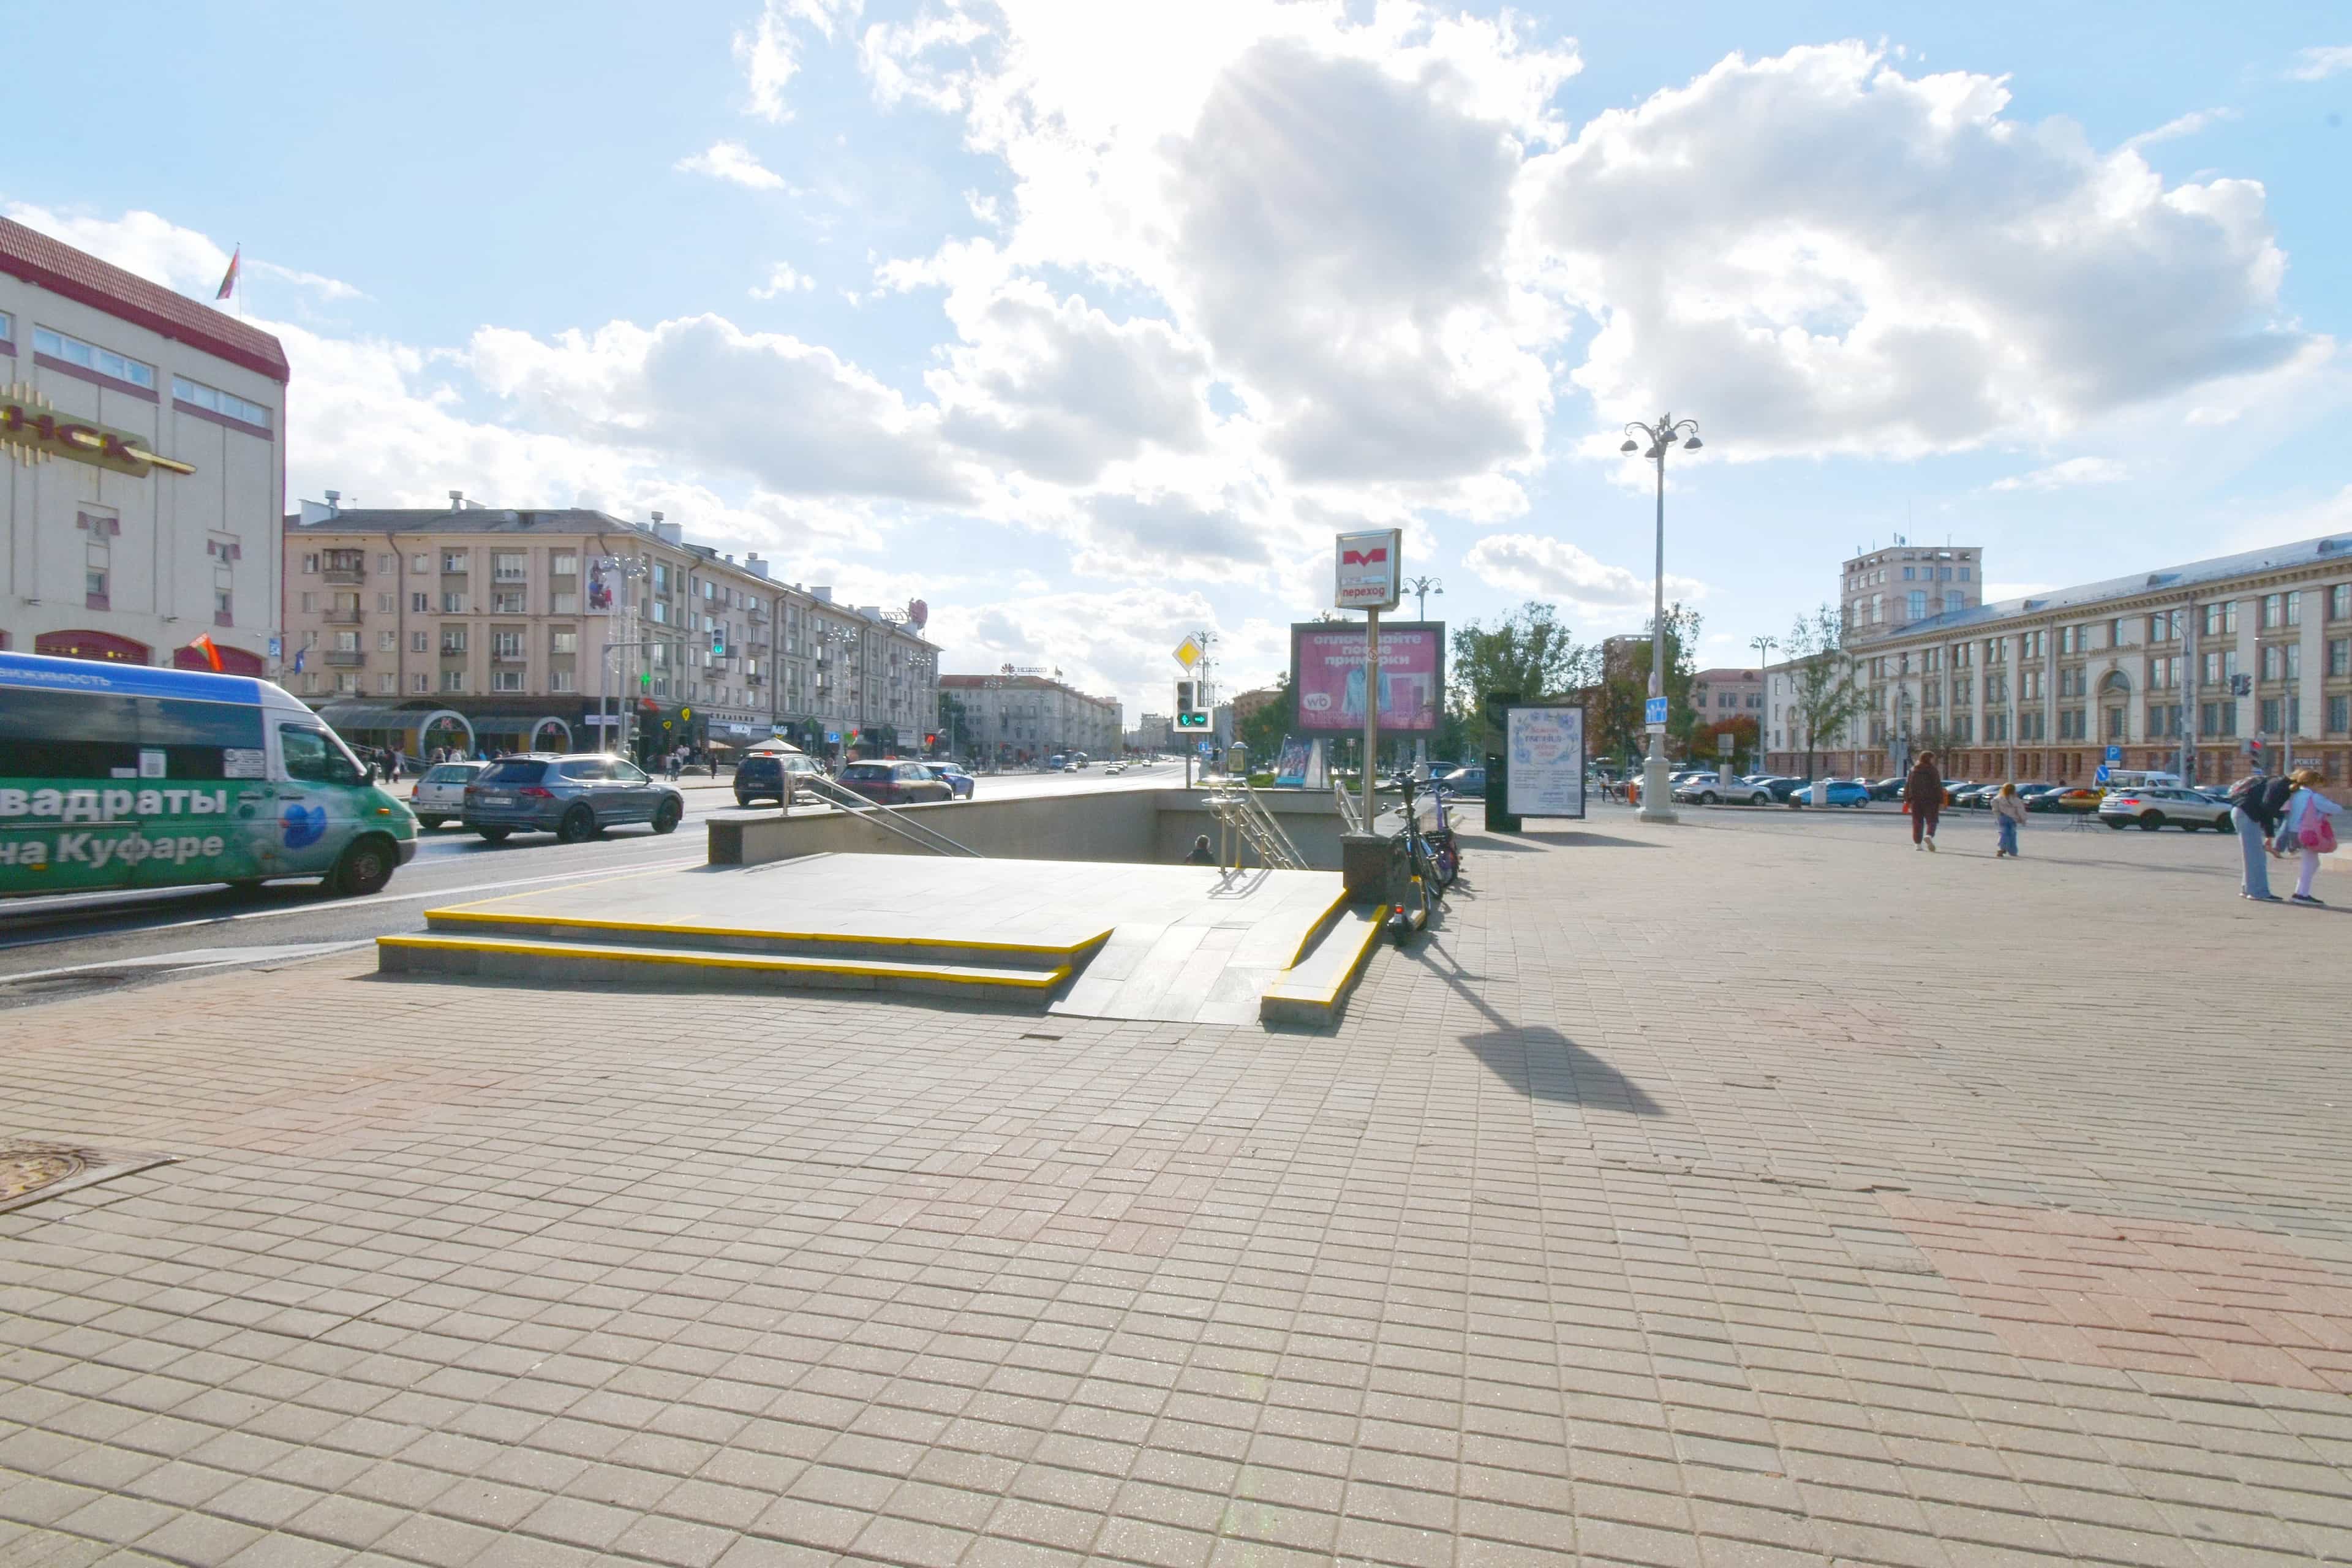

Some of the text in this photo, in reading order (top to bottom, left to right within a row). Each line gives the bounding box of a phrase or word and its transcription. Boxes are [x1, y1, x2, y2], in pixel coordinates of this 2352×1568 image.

[1343, 587, 1385, 598] переход
[1314, 633, 1422, 644] оплачайте
[1325, 656, 1409, 666] примрки
[1306, 695, 1328, 706] wb
[2109, 747, 2117, 758] P
[0, 789, 227, 821] вадраты
[57, 832, 224, 869] Куфаре
